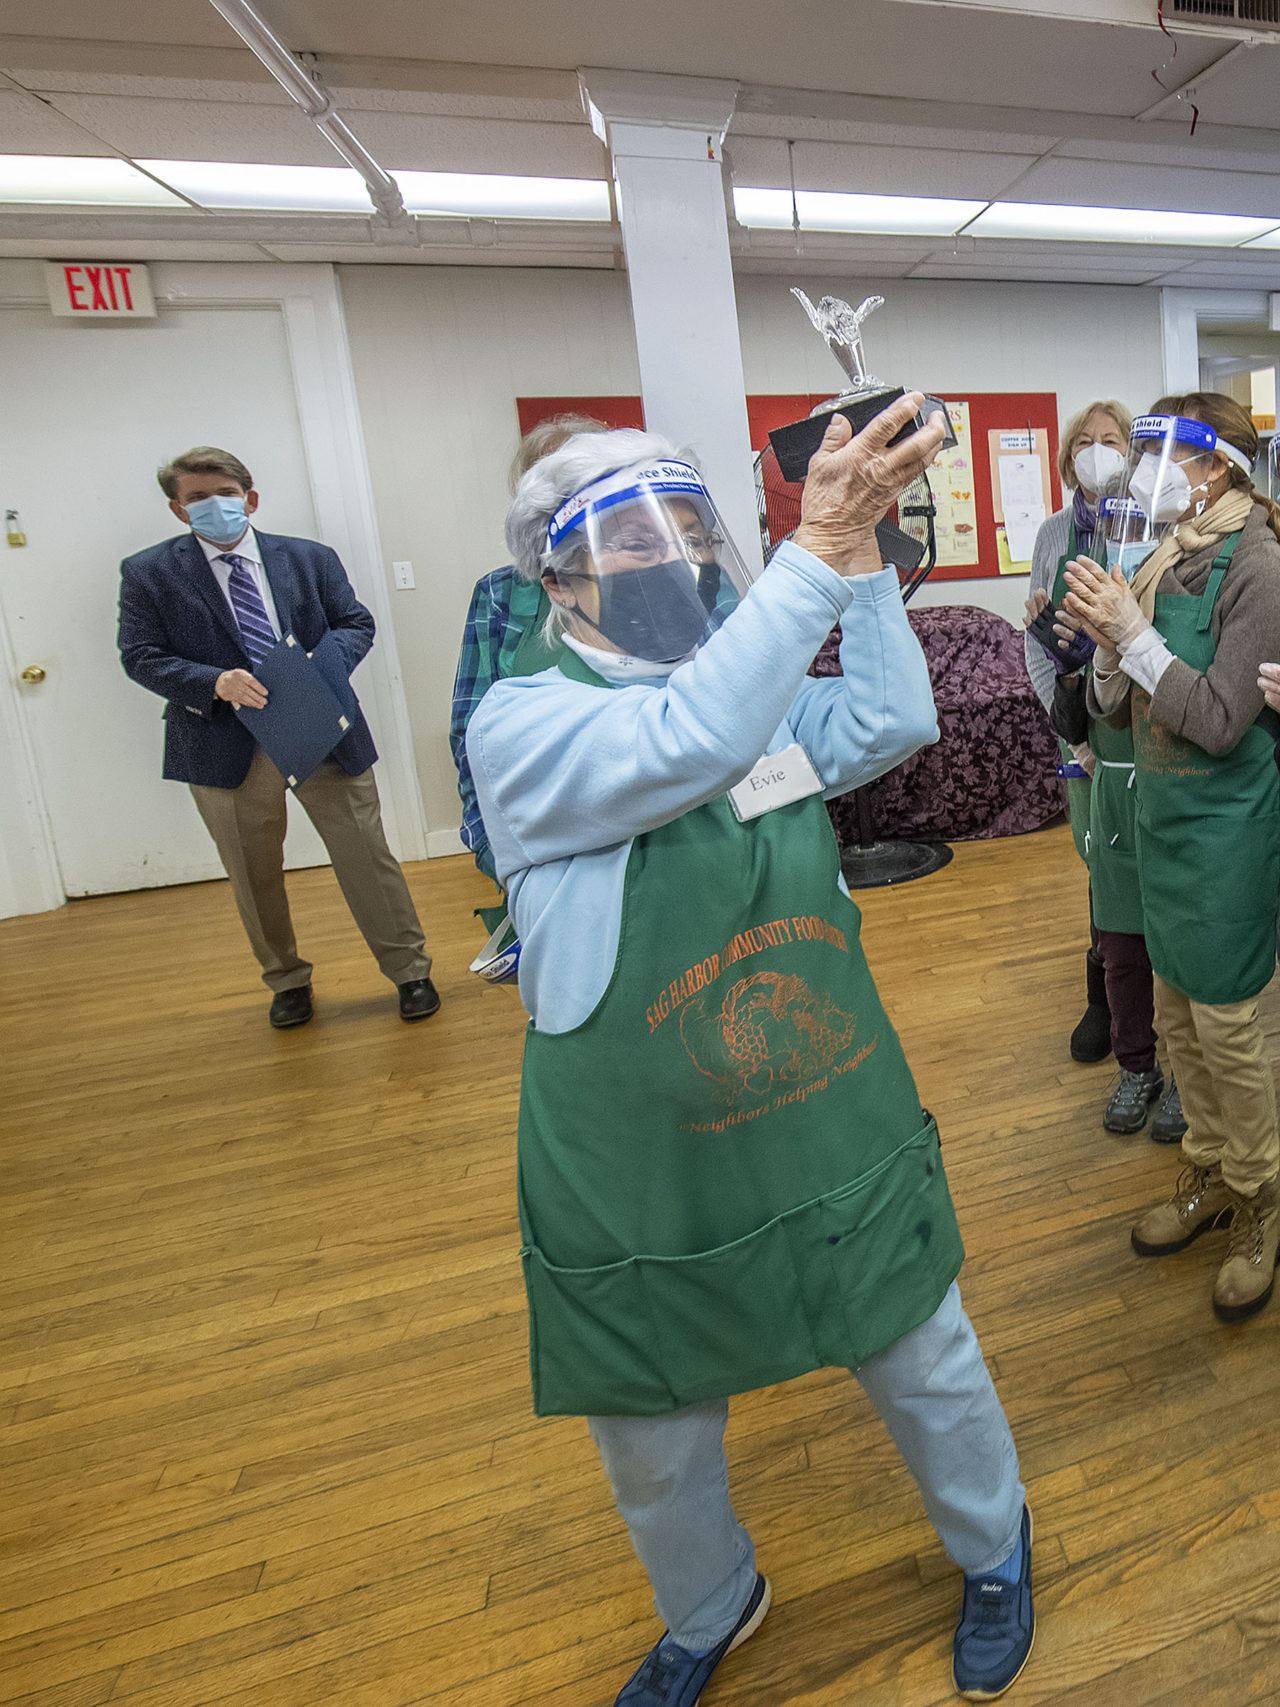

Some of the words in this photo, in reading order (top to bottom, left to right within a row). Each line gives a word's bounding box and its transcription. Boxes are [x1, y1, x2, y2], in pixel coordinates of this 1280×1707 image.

[64, 266, 134, 311] EXIT
[664, 465, 697, 481] Shield
[749, 769, 786, 792] Evie
[645, 990, 670, 1034] SAG
[668, 953, 721, 1010] HARBOR
[791, 915, 826, 942] FOOD
[773, 1074, 829, 1111] Helping
